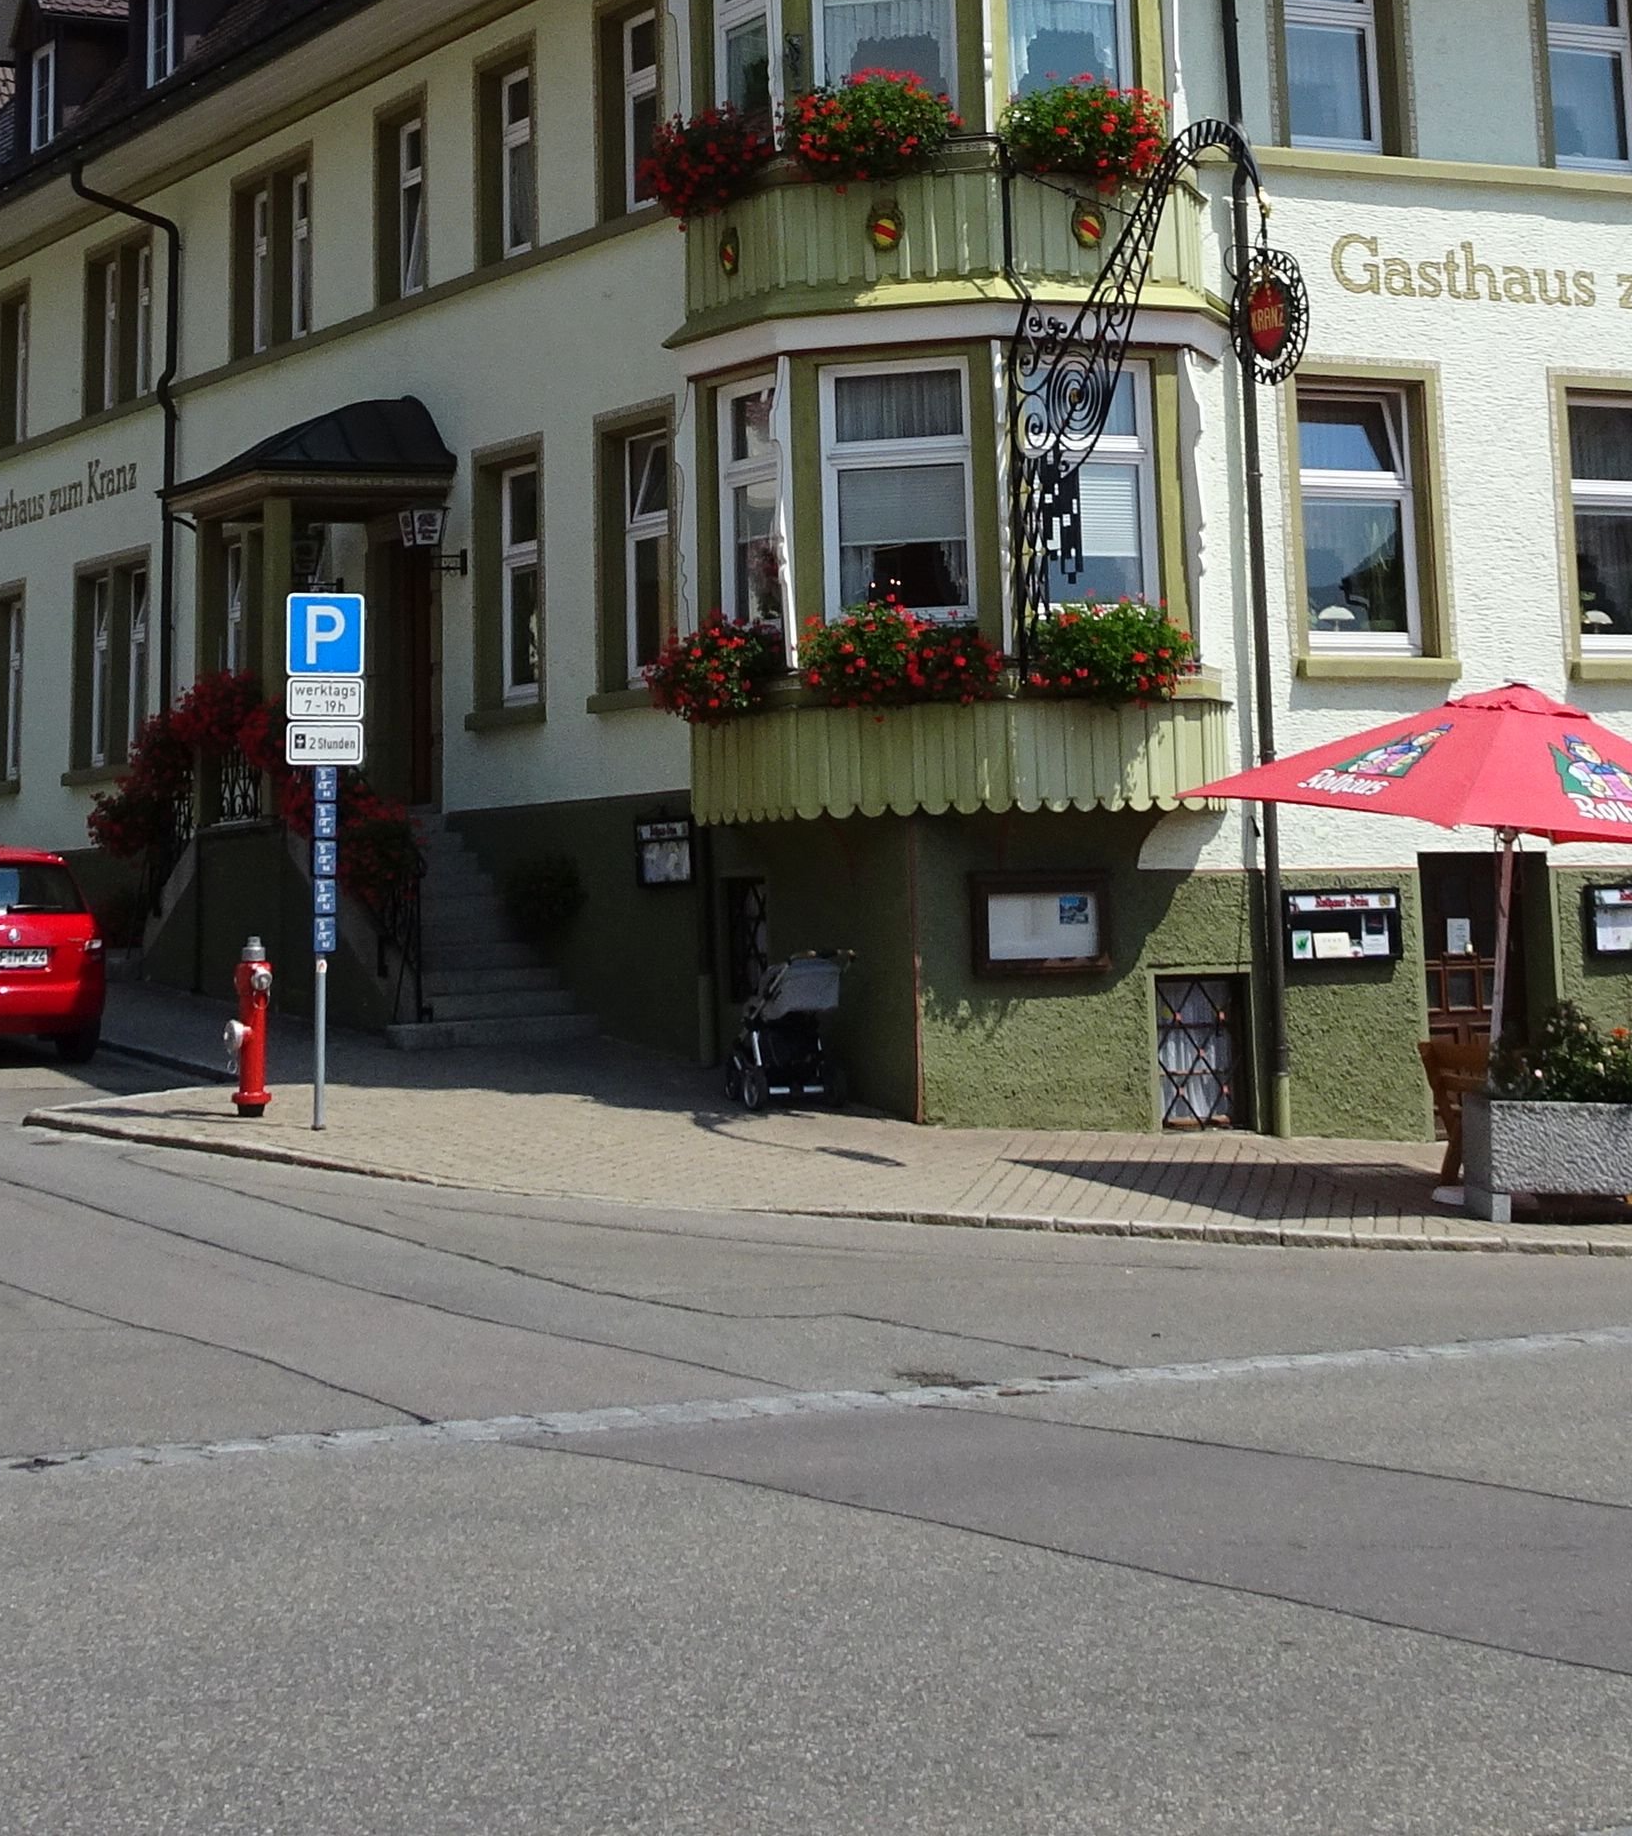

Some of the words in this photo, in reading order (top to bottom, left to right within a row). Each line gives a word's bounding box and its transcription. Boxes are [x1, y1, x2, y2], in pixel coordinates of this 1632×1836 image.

[1330, 233, 1596, 309] Gasthaus
[1251, 304, 1285, 333] KRANZ
[49, 480, 83, 516] zum
[87, 459, 137, 504] Kranz
[306, 605, 345, 664] P
[295, 685, 356, 699] werktags
[304, 700, 311, 712] 7
[309, 737, 316, 749] 2
[318, 737, 356, 750] Stunden
